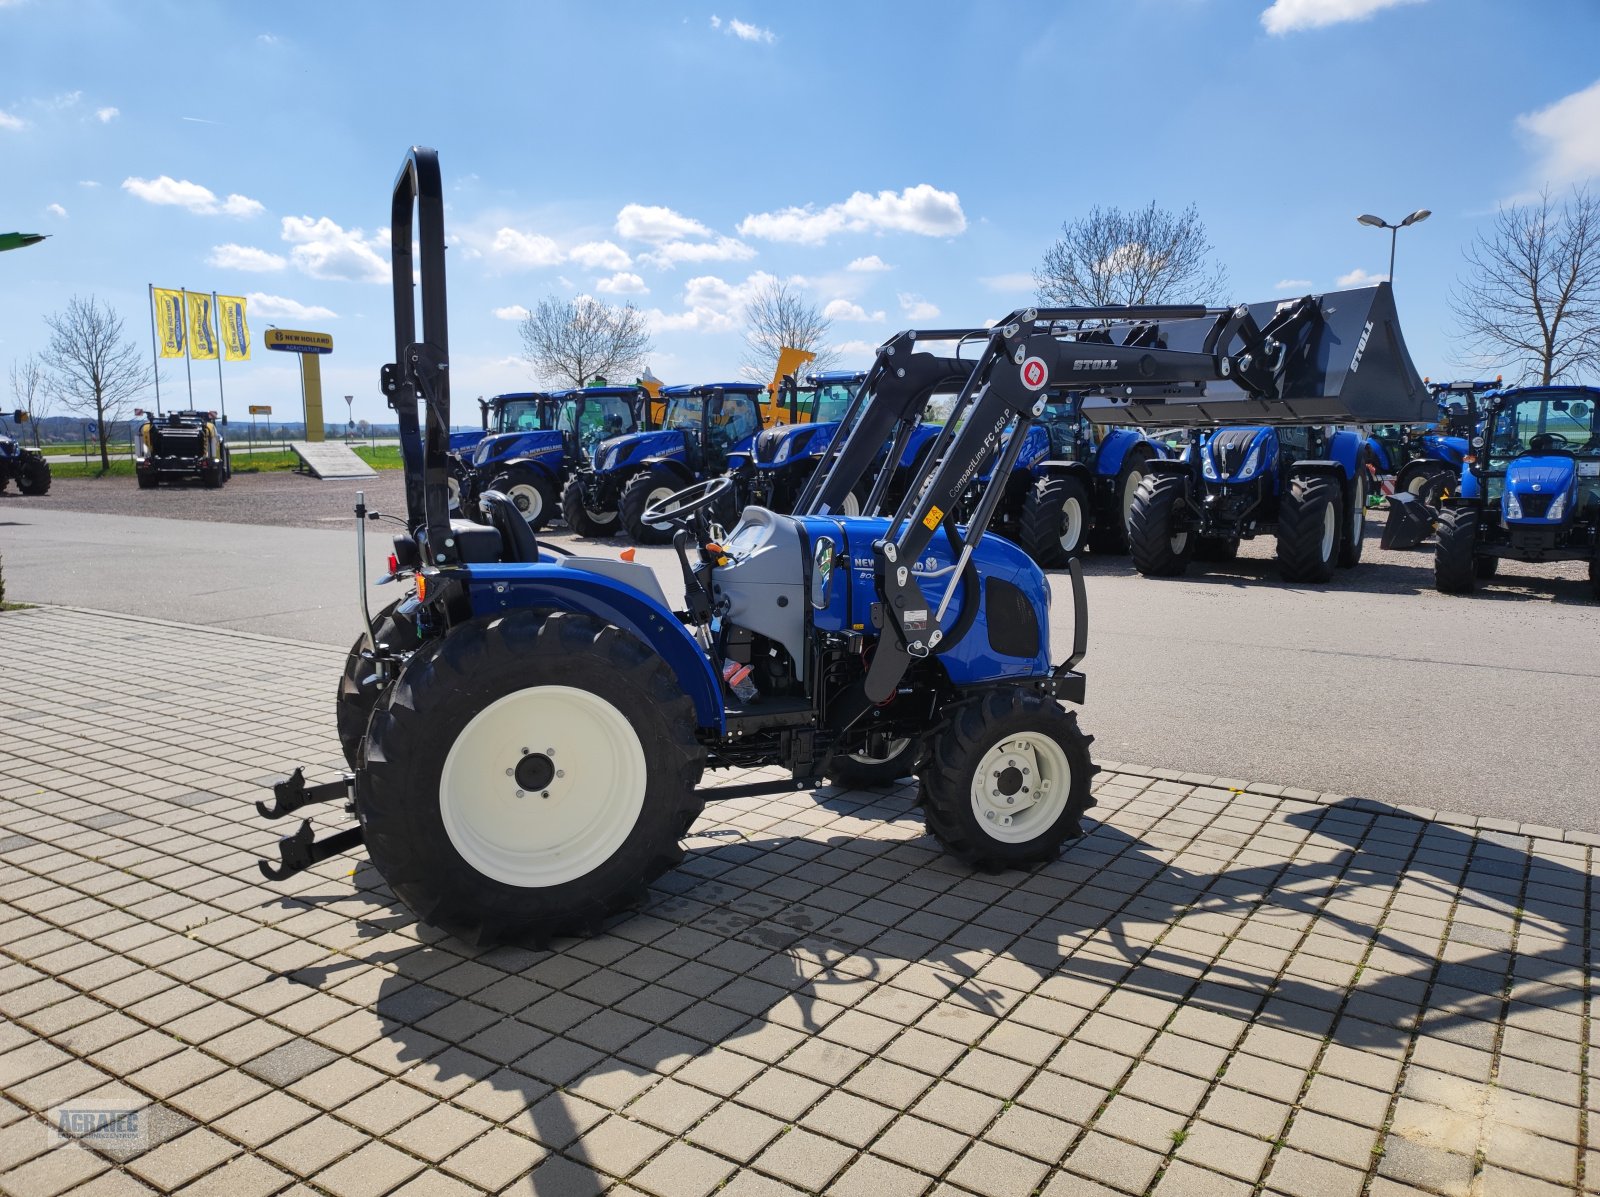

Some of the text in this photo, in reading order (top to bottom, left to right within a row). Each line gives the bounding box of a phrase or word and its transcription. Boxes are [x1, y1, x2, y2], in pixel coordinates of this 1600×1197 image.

[300, 335, 330, 344] HOLLAND
[285, 344, 320, 353] AGRICULTURE
[1350, 320, 1374, 373] STOLL
[1072, 359, 1118, 370] STOLL
[949, 408, 1010, 498] CompactLine FC 450 P
[854, 558, 875, 567] NEW
